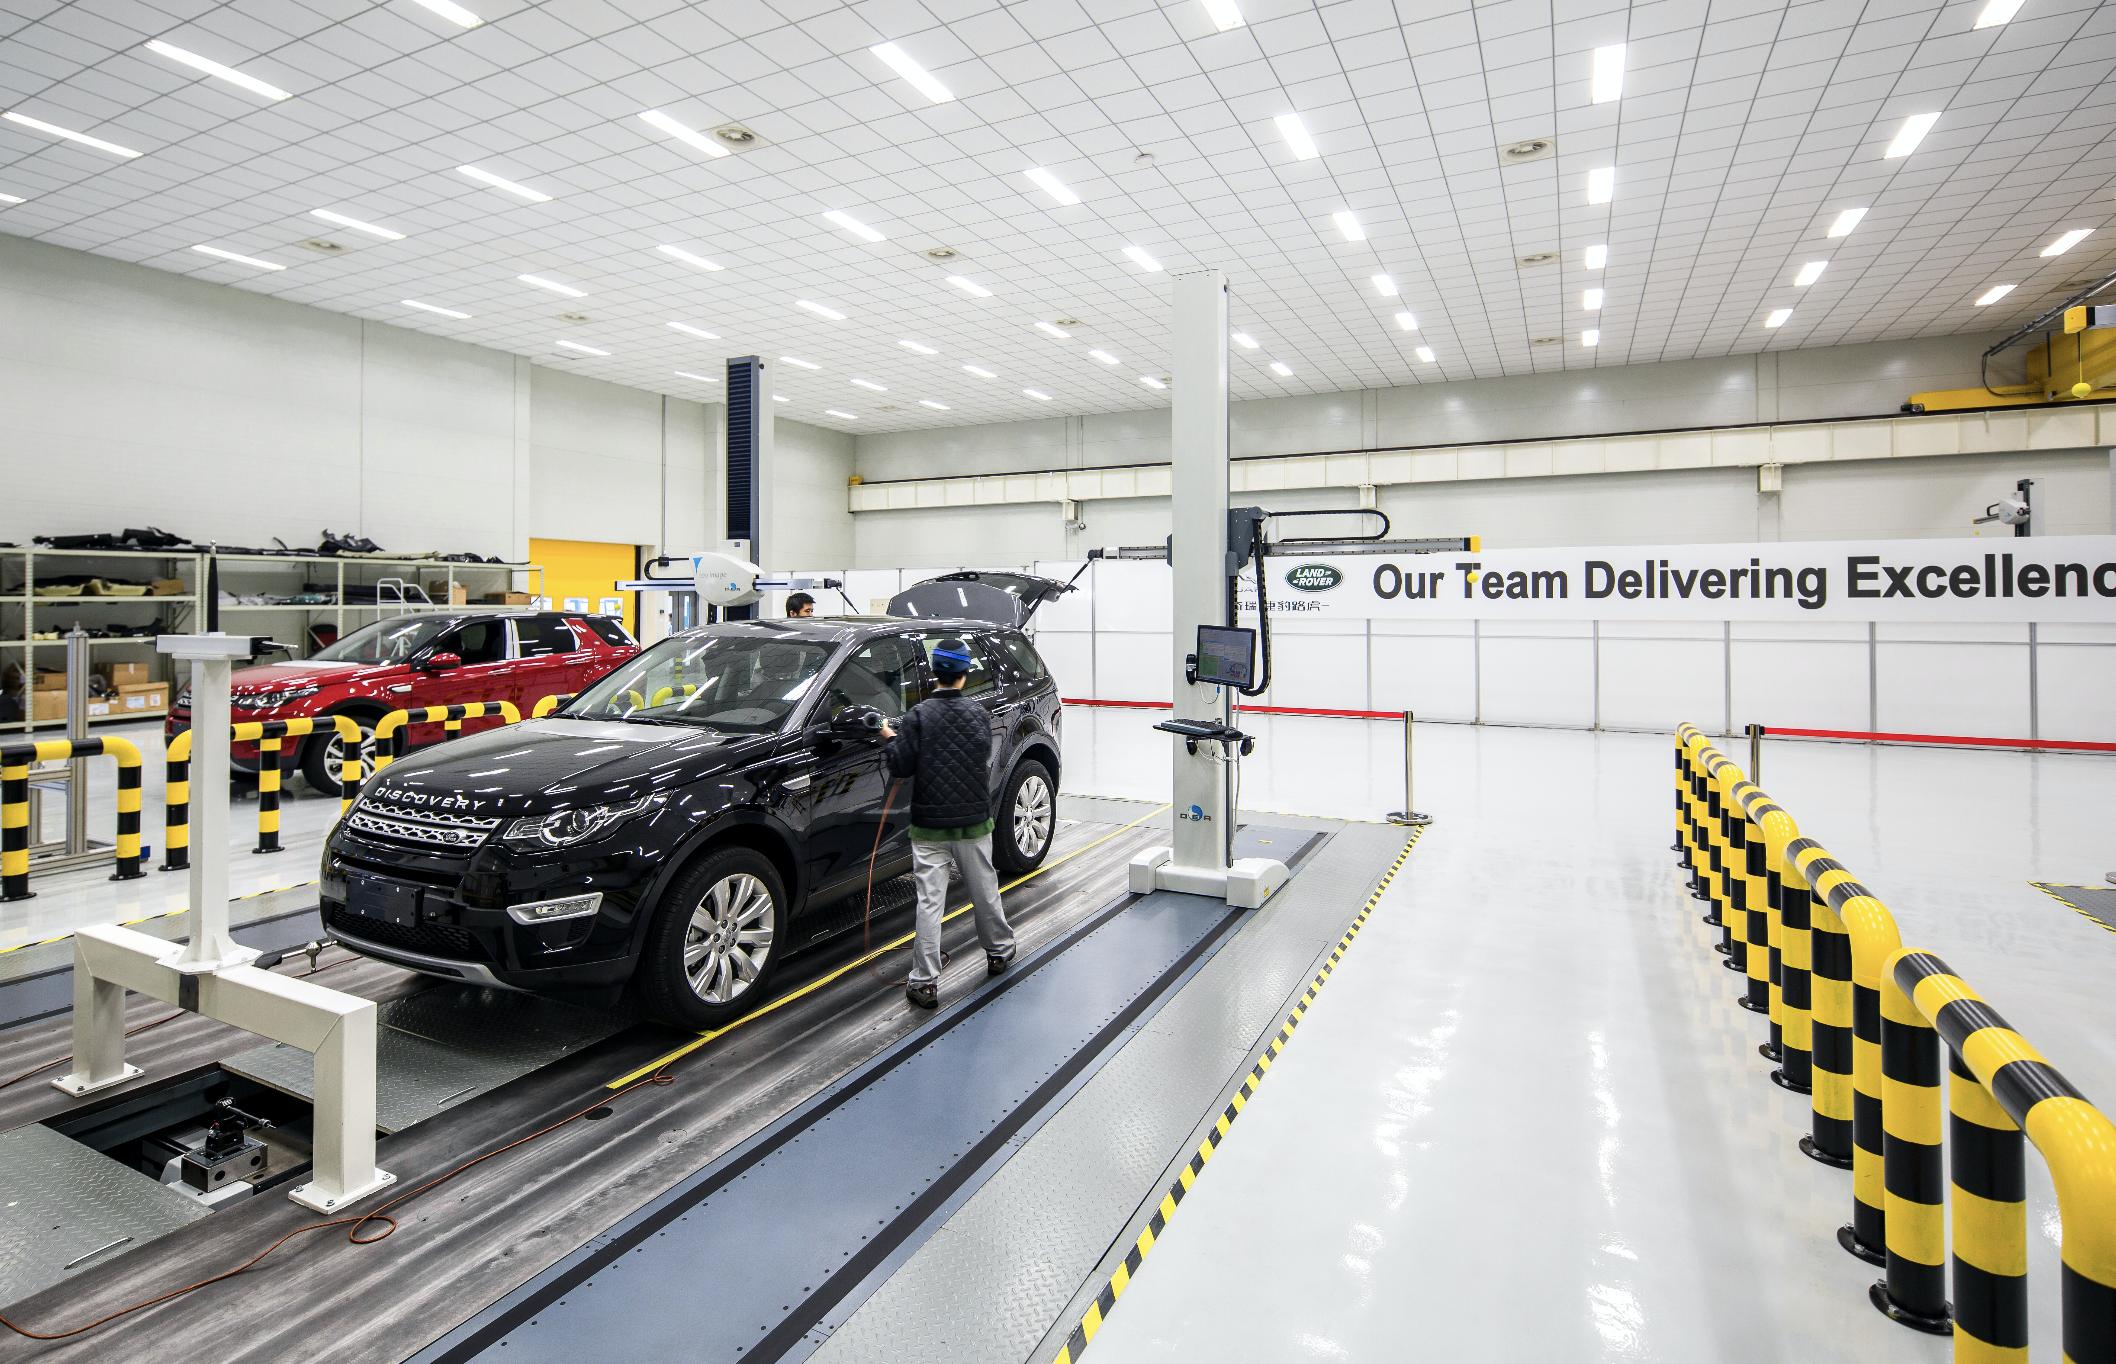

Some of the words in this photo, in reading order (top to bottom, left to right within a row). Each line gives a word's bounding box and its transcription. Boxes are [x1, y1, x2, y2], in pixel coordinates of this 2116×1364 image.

[1295, 568, 1325, 578] LAND
[1298, 577, 1334, 587] ROVER
[1373, 563, 1445, 600] Our
[1455, 562, 1568, 600] Team
[1585, 558, 1827, 610] Delivering
[1847, 553, 2116, 599] Excellenc
[374, 787, 487, 810] DISCOVERY
